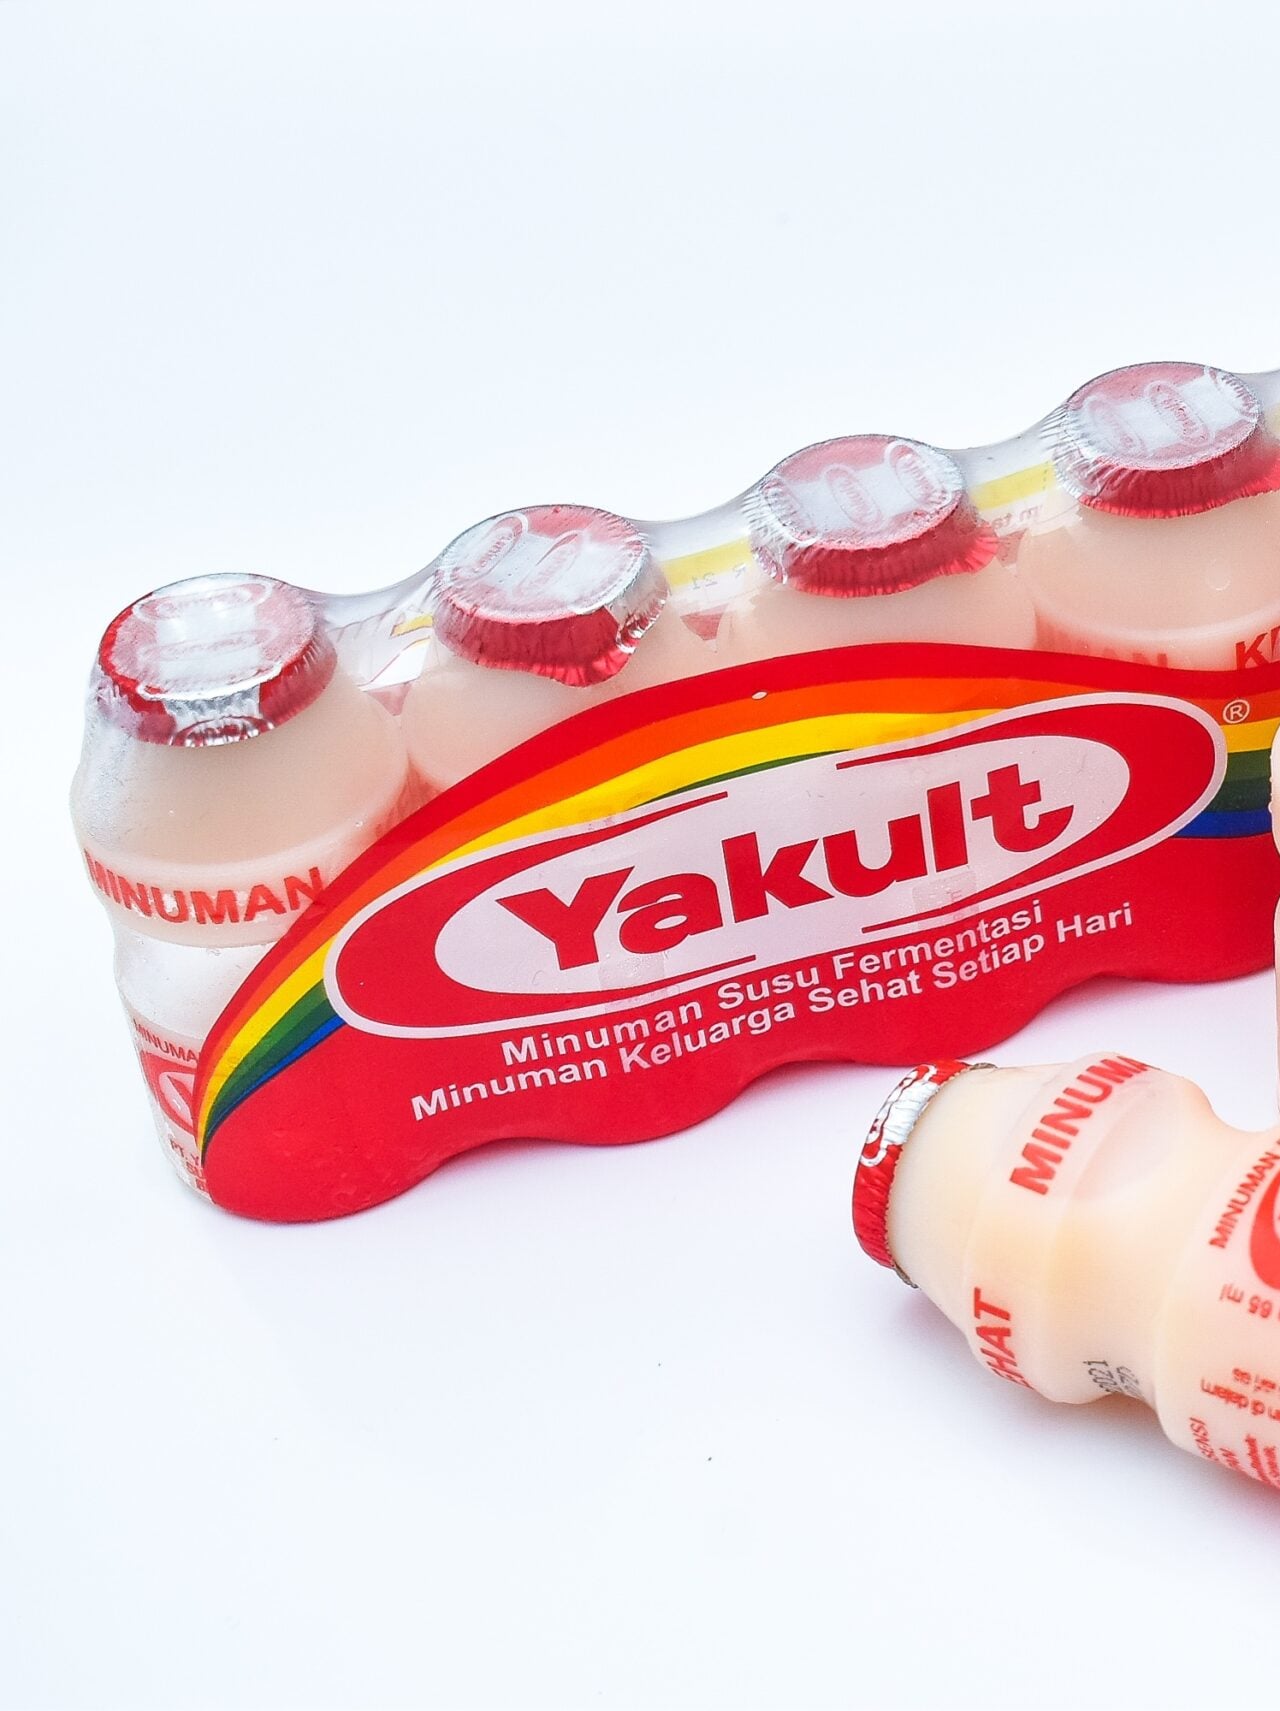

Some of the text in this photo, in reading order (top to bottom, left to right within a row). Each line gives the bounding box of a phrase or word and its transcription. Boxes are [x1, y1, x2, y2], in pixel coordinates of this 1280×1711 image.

[84, 847, 326, 925] MINUMAN
[495, 764, 1074, 970] Yakult
[132, 1018, 200, 1064] MINUMA
[410, 901, 1134, 1122] Minuman Keluarga Sehat Setiap Hari
[502, 898, 1043, 1067] Minuman Susu Fermentasi
[1009, 1055, 1151, 1197] MINUMA
[974, 1286, 1034, 1391] HAT
